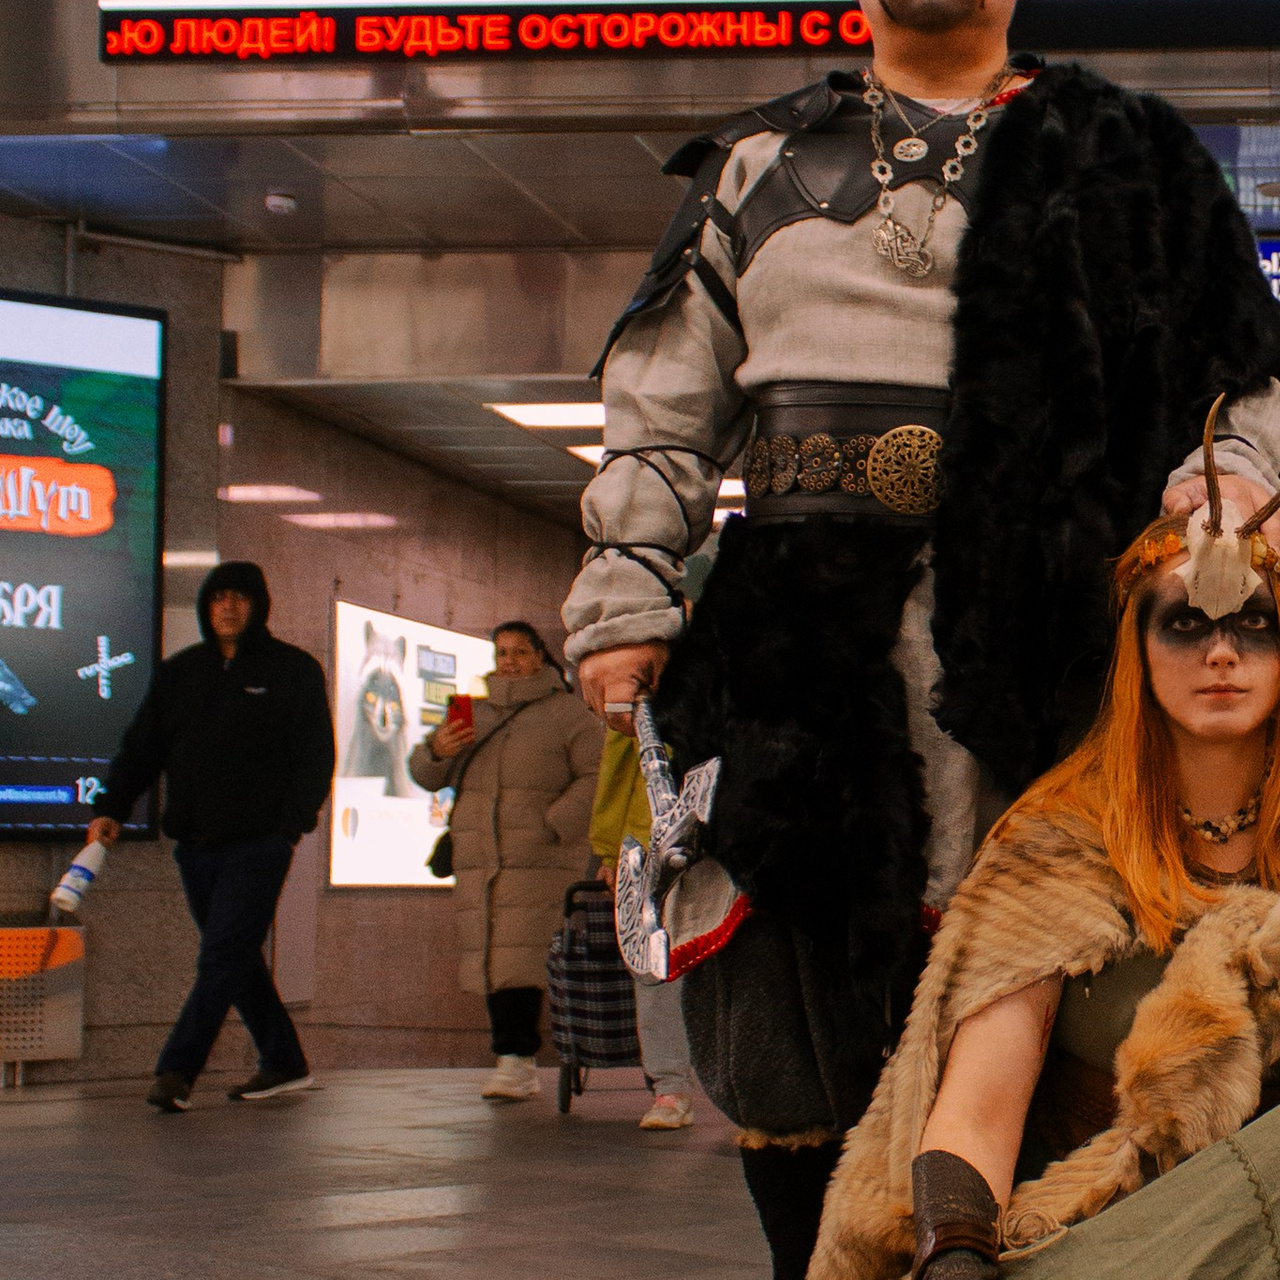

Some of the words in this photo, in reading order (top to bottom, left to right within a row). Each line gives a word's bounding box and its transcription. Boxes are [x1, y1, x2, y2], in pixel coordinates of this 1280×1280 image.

[170, 11, 336, 60] ЛЮДЕЙ!
[355, 14, 510, 58] БУДЬТЕ
[518, 9, 791, 49] ОСТОРОЖНЫ
[800, 9, 831, 46] С
